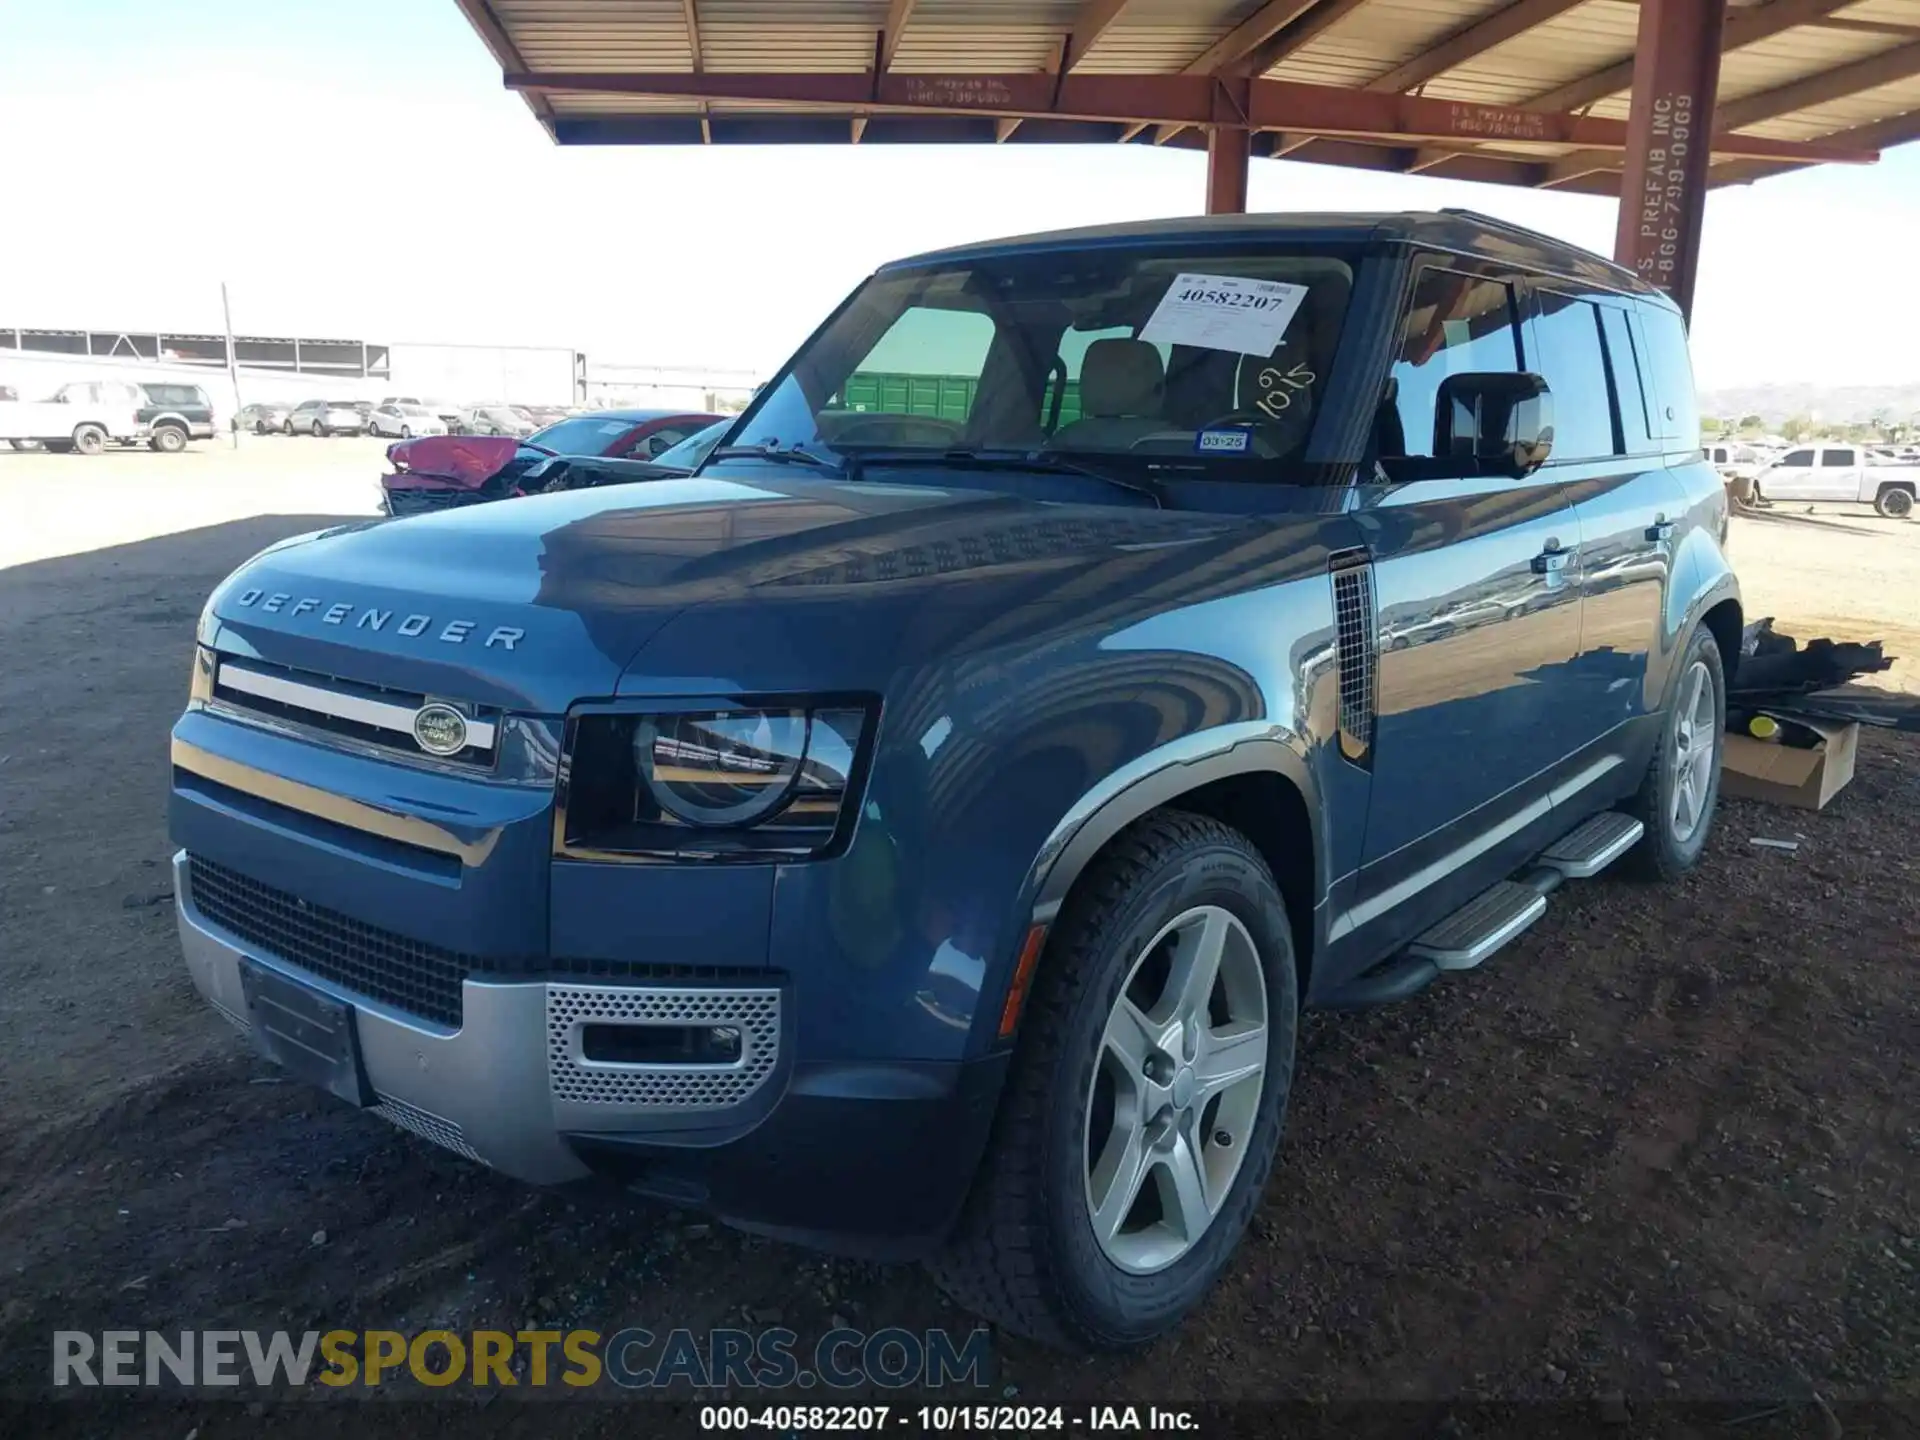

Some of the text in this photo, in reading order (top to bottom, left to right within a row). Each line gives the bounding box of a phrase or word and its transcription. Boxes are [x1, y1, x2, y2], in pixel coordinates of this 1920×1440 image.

[1652, 91, 1674, 135] INC.
[1641, 149, 1667, 237] PREFAB
[1178, 288, 1283, 313] 40582207
[239, 589, 526, 651] DEFENDER
